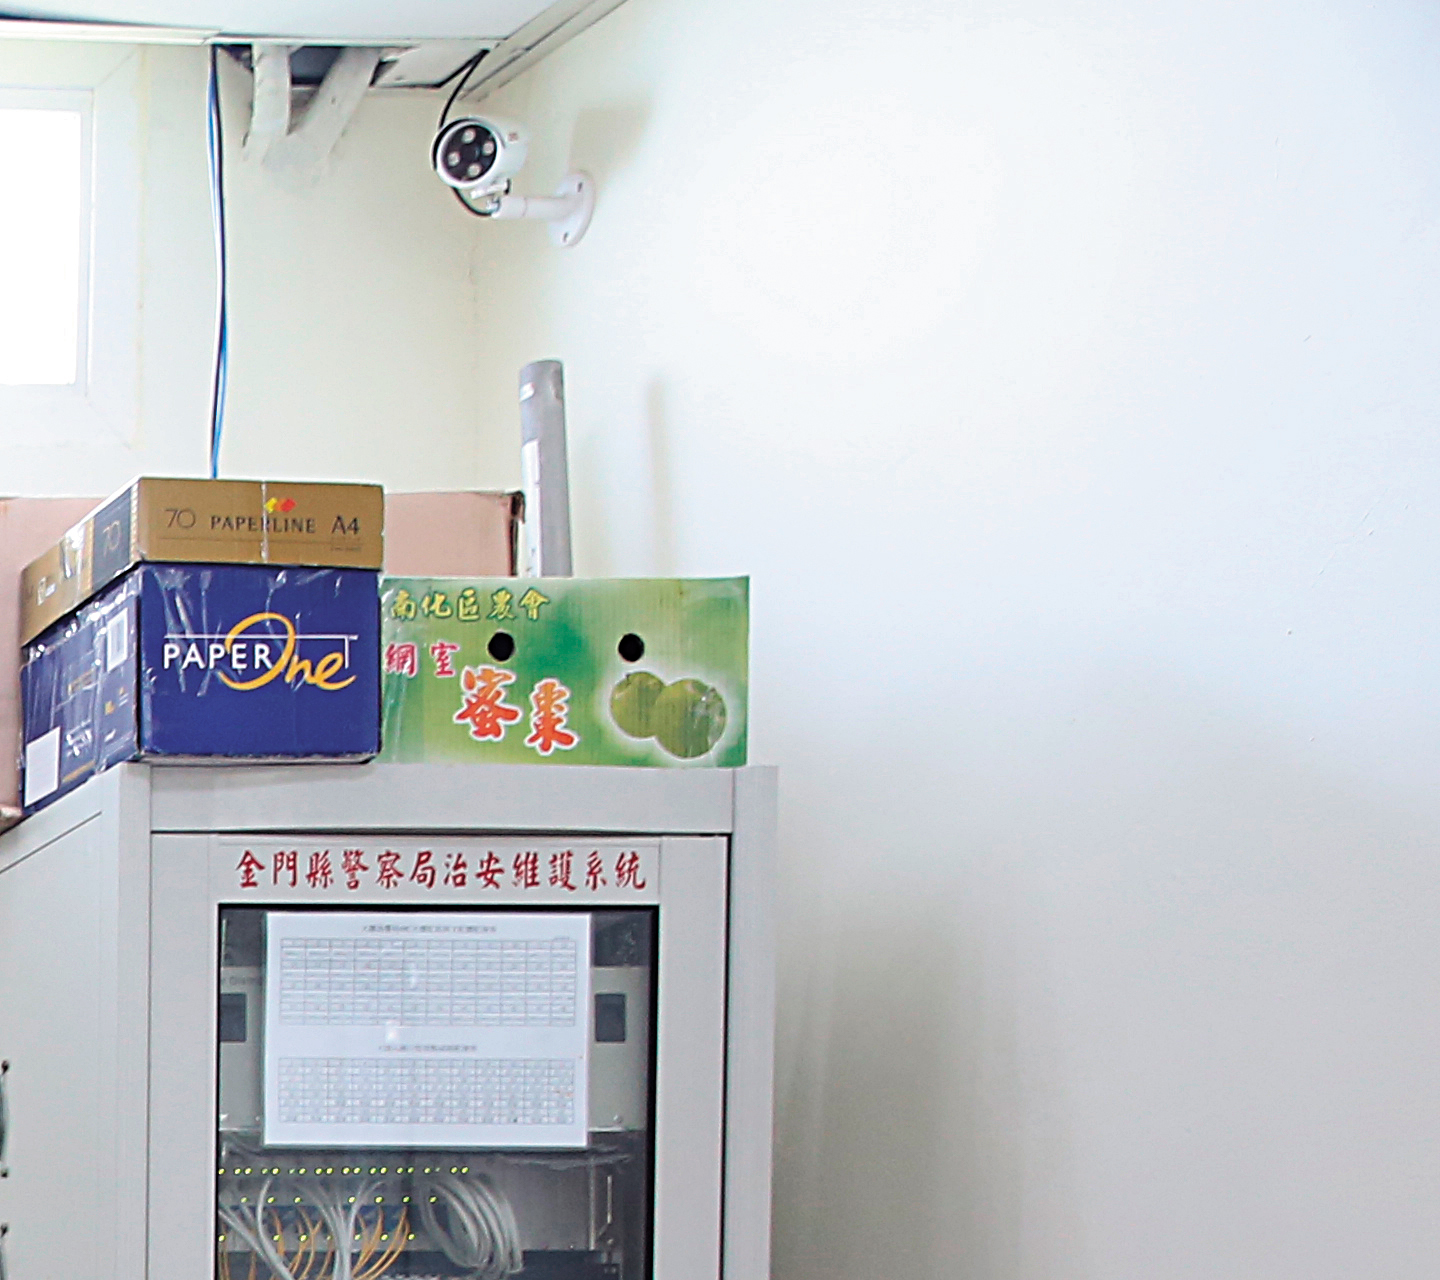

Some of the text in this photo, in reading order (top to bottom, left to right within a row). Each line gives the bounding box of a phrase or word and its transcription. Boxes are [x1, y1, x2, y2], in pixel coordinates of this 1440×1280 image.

[165, 508, 361, 535] 70 PAPERLINE A4
[390, 588, 550, 622] 南化區農會
[383, 641, 460, 678] 網室
[235, 849, 647, 892] 金門縣警察局治安維護系統
